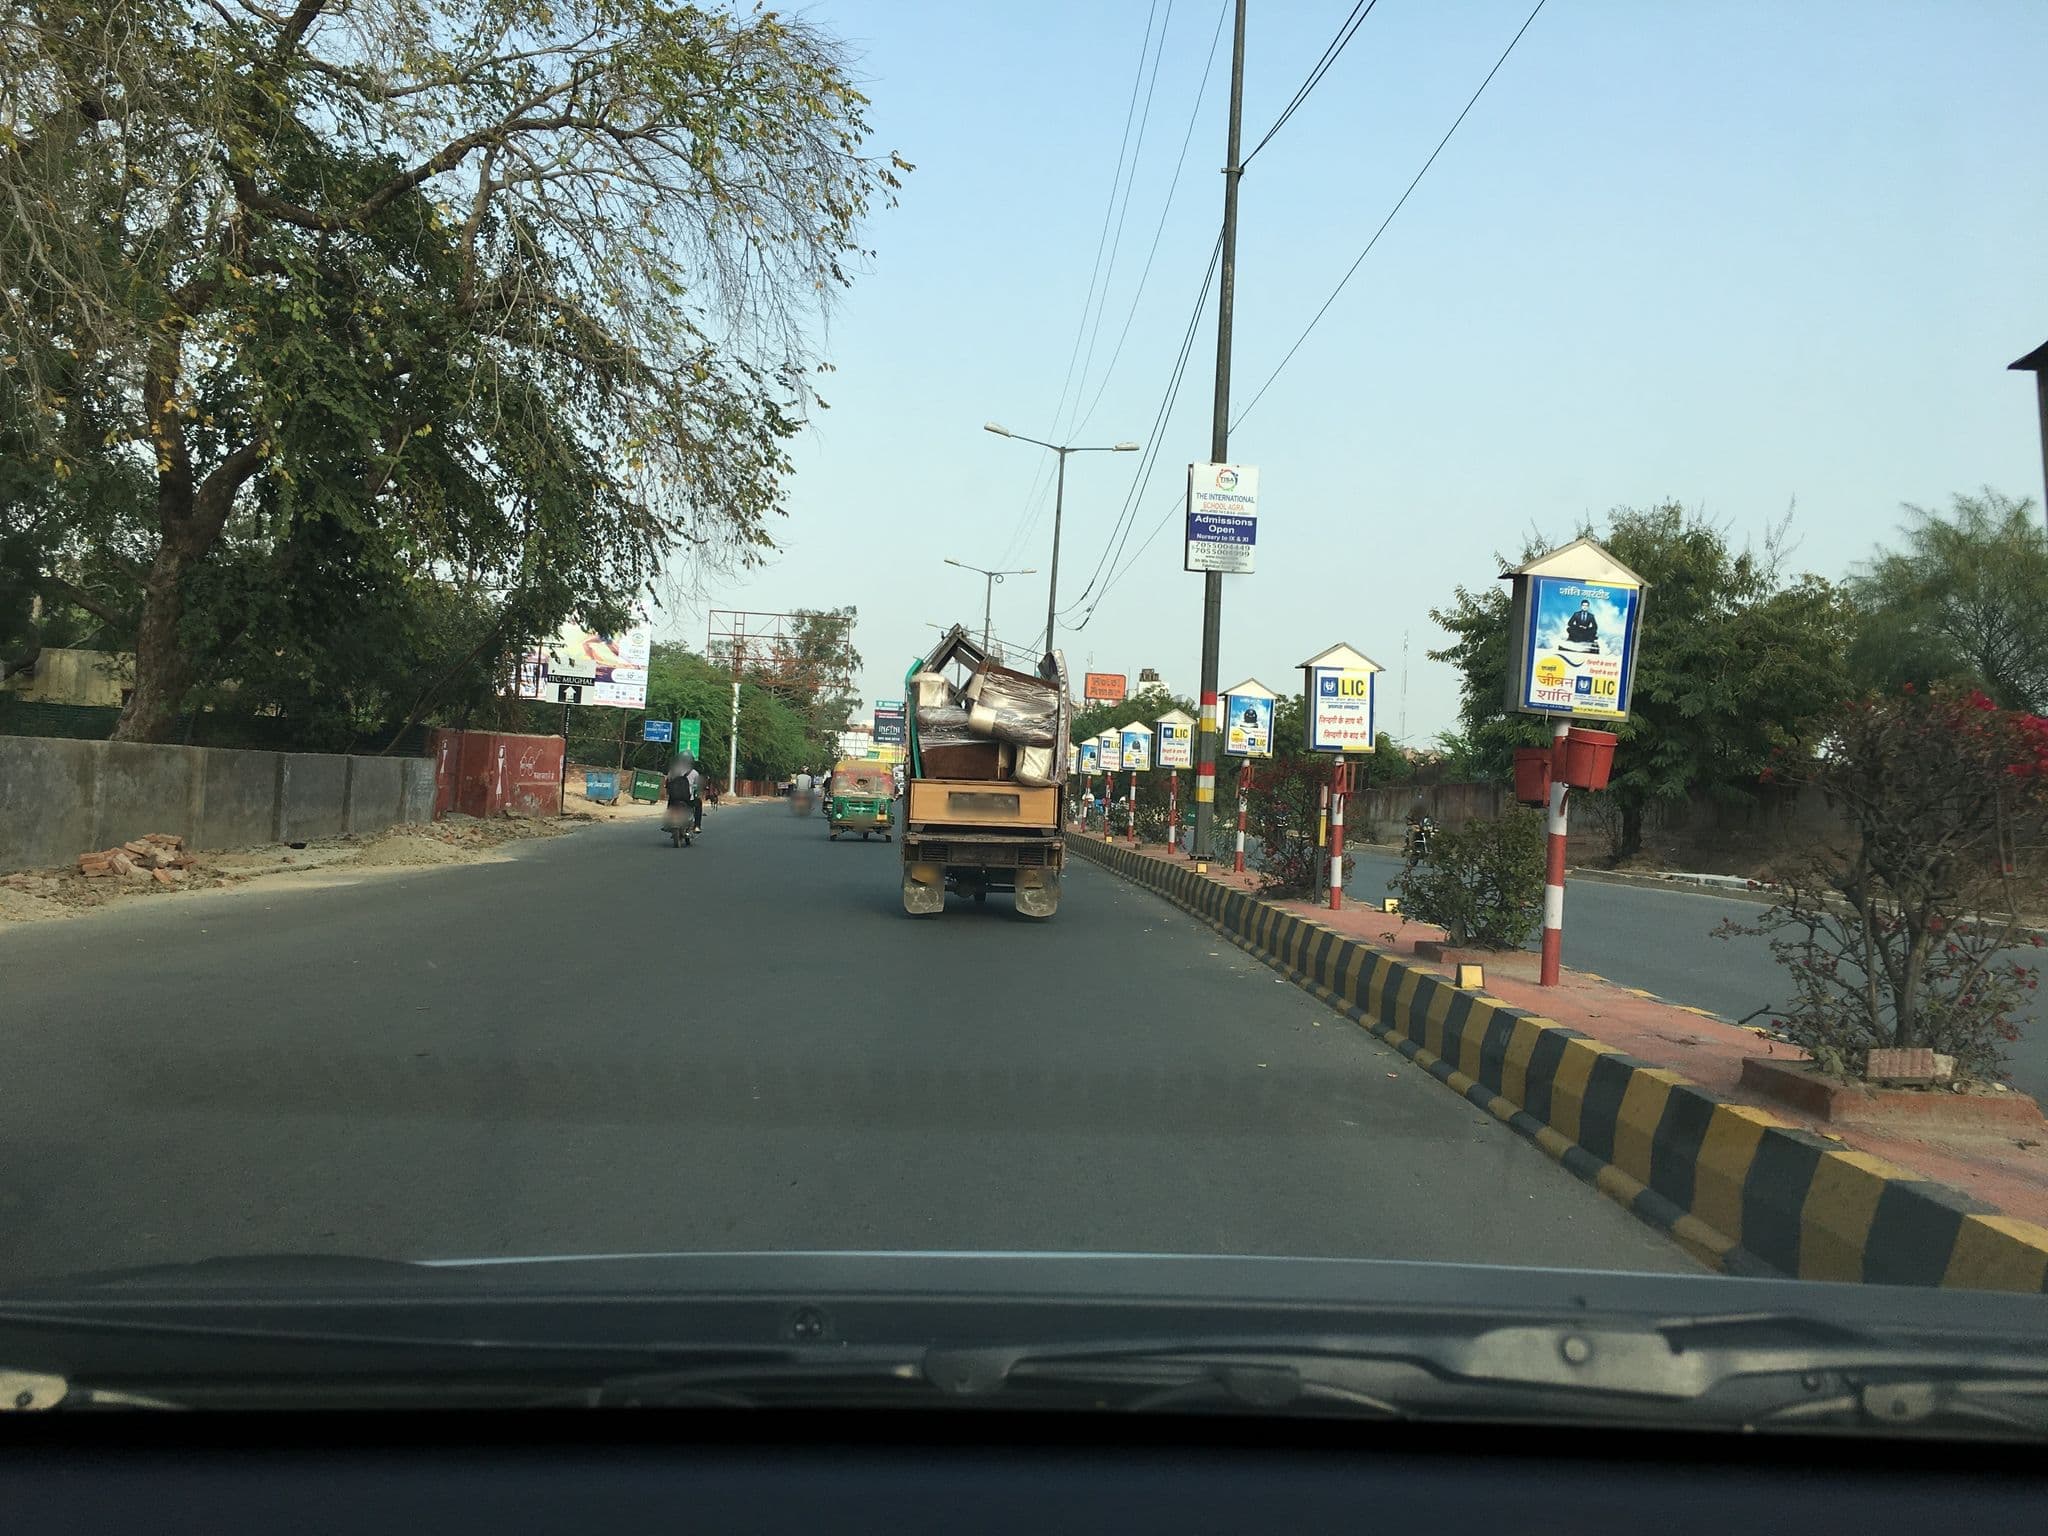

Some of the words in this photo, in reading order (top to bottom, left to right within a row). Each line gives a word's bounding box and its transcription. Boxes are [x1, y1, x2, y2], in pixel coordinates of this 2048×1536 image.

[1196, 492, 1208, 500] THE
[1209, 493, 1255, 504] INTERNATIONAL
[1203, 502, 1226, 510] SCHOOL
[1194, 515, 1253, 526] Admissions
[1208, 524, 1235, 534] Open
[1196, 533, 1220, 541] Nursery
[1560, 585, 1580, 596] शांति
[548, 675, 560, 683] ITC
[562, 676, 593, 685] MUGHAL
[1537, 672, 1574, 688] जीवन
[1341, 679, 1364, 696] LIC
[1594, 679, 1615, 696] LIC
[1536, 688, 1572, 703] शांति
[1175, 729, 1188, 738] LIC
